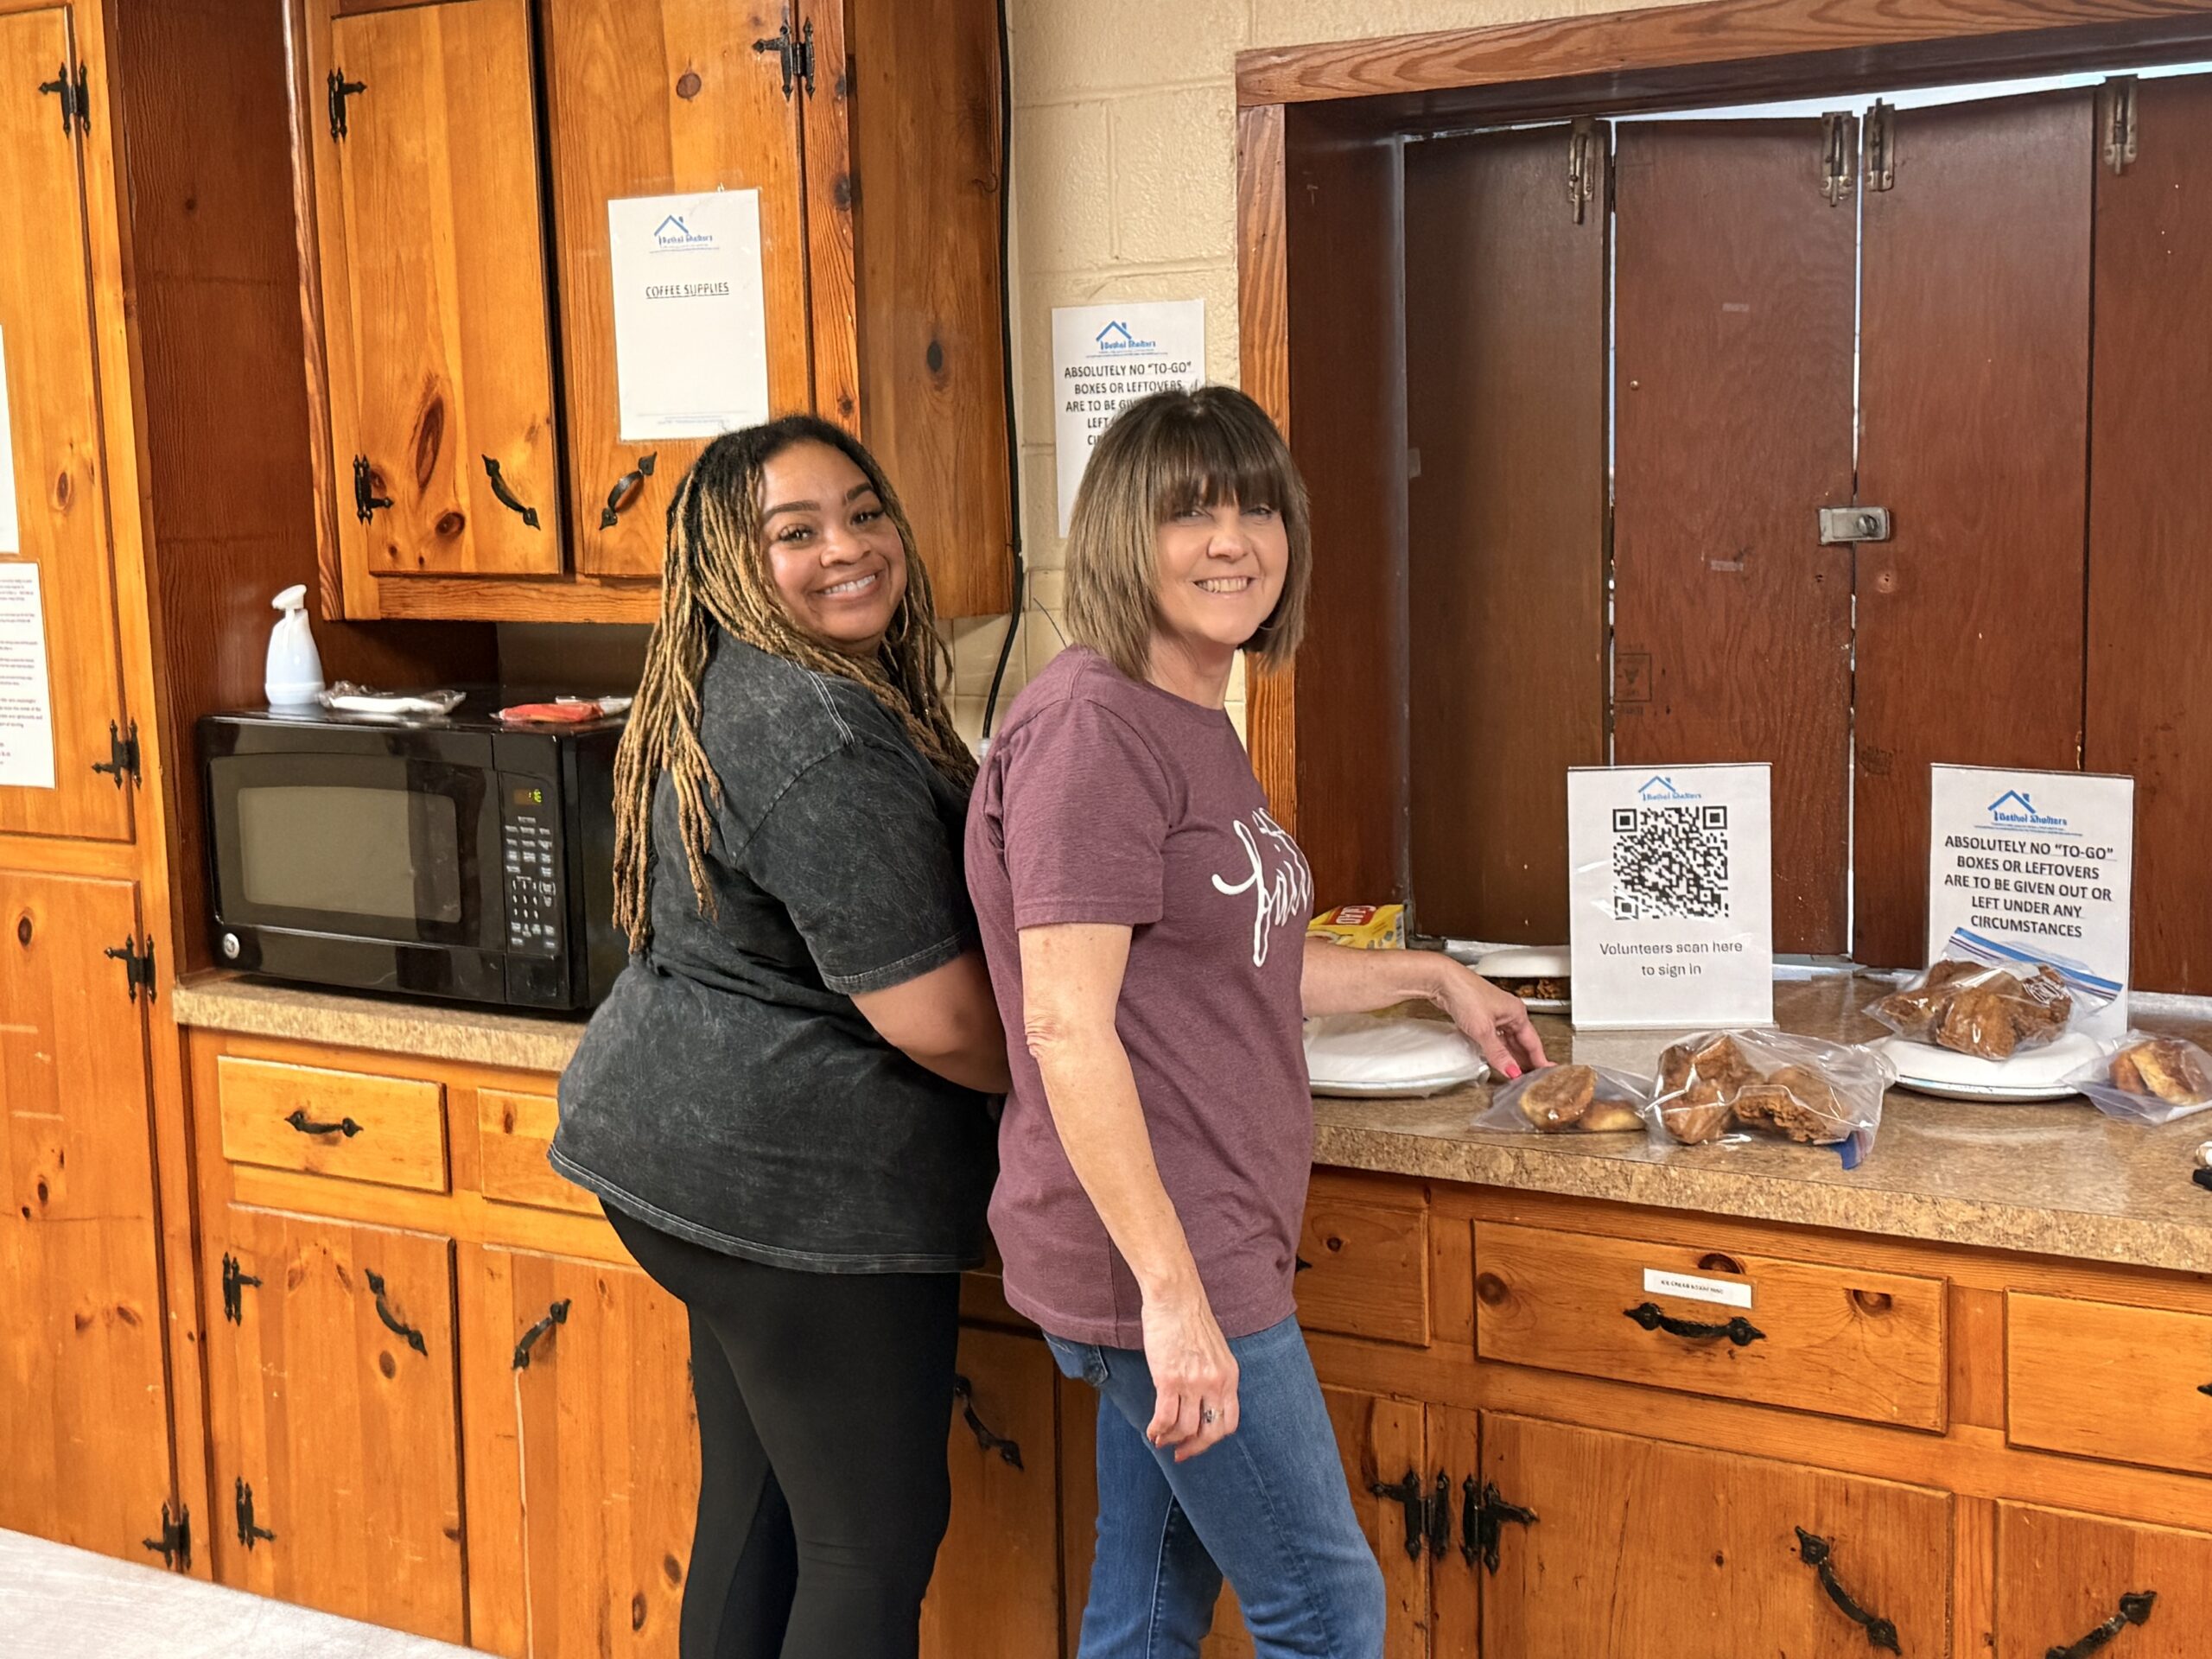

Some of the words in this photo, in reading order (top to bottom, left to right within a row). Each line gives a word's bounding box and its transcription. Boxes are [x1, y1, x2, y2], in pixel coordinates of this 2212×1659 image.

[645, 285, 681, 297] COFFEE
[683, 282, 729, 296] SUPPLIES
[1065, 365, 1126, 378] ABSOLUTELY
[1129, 364, 1145, 375] NO
[1075, 384, 1107, 395] BOXES
[1109, 382, 1123, 393] OR
[1127, 380, 1182, 392] LEFTOVERS
[1065, 401, 1084, 412] ARE
[1088, 400, 1102, 411] TO
[1104, 399, 1116, 410] BE
[1087, 416, 1108, 429] LEFT
[1945, 836, 2025, 854] ABSOLUTELY
[2030, 842, 2050, 855] NO
[1957, 855, 1999, 871] BOXES
[2003, 860, 2021, 873] OR
[2025, 861, 2100, 879] LEFTOVERS
[1945, 874, 1970, 887] ARE
[1973, 876, 1991, 889] TO
[1994, 879, 2010, 891] BE
[2014, 880, 2055, 895] GIVEN
[2059, 884, 2088, 899] OUT
[2091, 887, 2112, 901] OR
[1972, 895, 1999, 909] LEFT
[2003, 899, 2050, 915] UNDER
[2053, 904, 2082, 918] ANY
[1971, 915, 2082, 938] CIRCUMSTANCES
[1599, 943, 1673, 955] Volunteers
[1676, 943, 1708, 953] scan
[1713, 941, 1743, 952] here
[1642, 965, 1655, 976] to
[1658, 963, 1686, 978] sign
[1689, 963, 1701, 975] in
